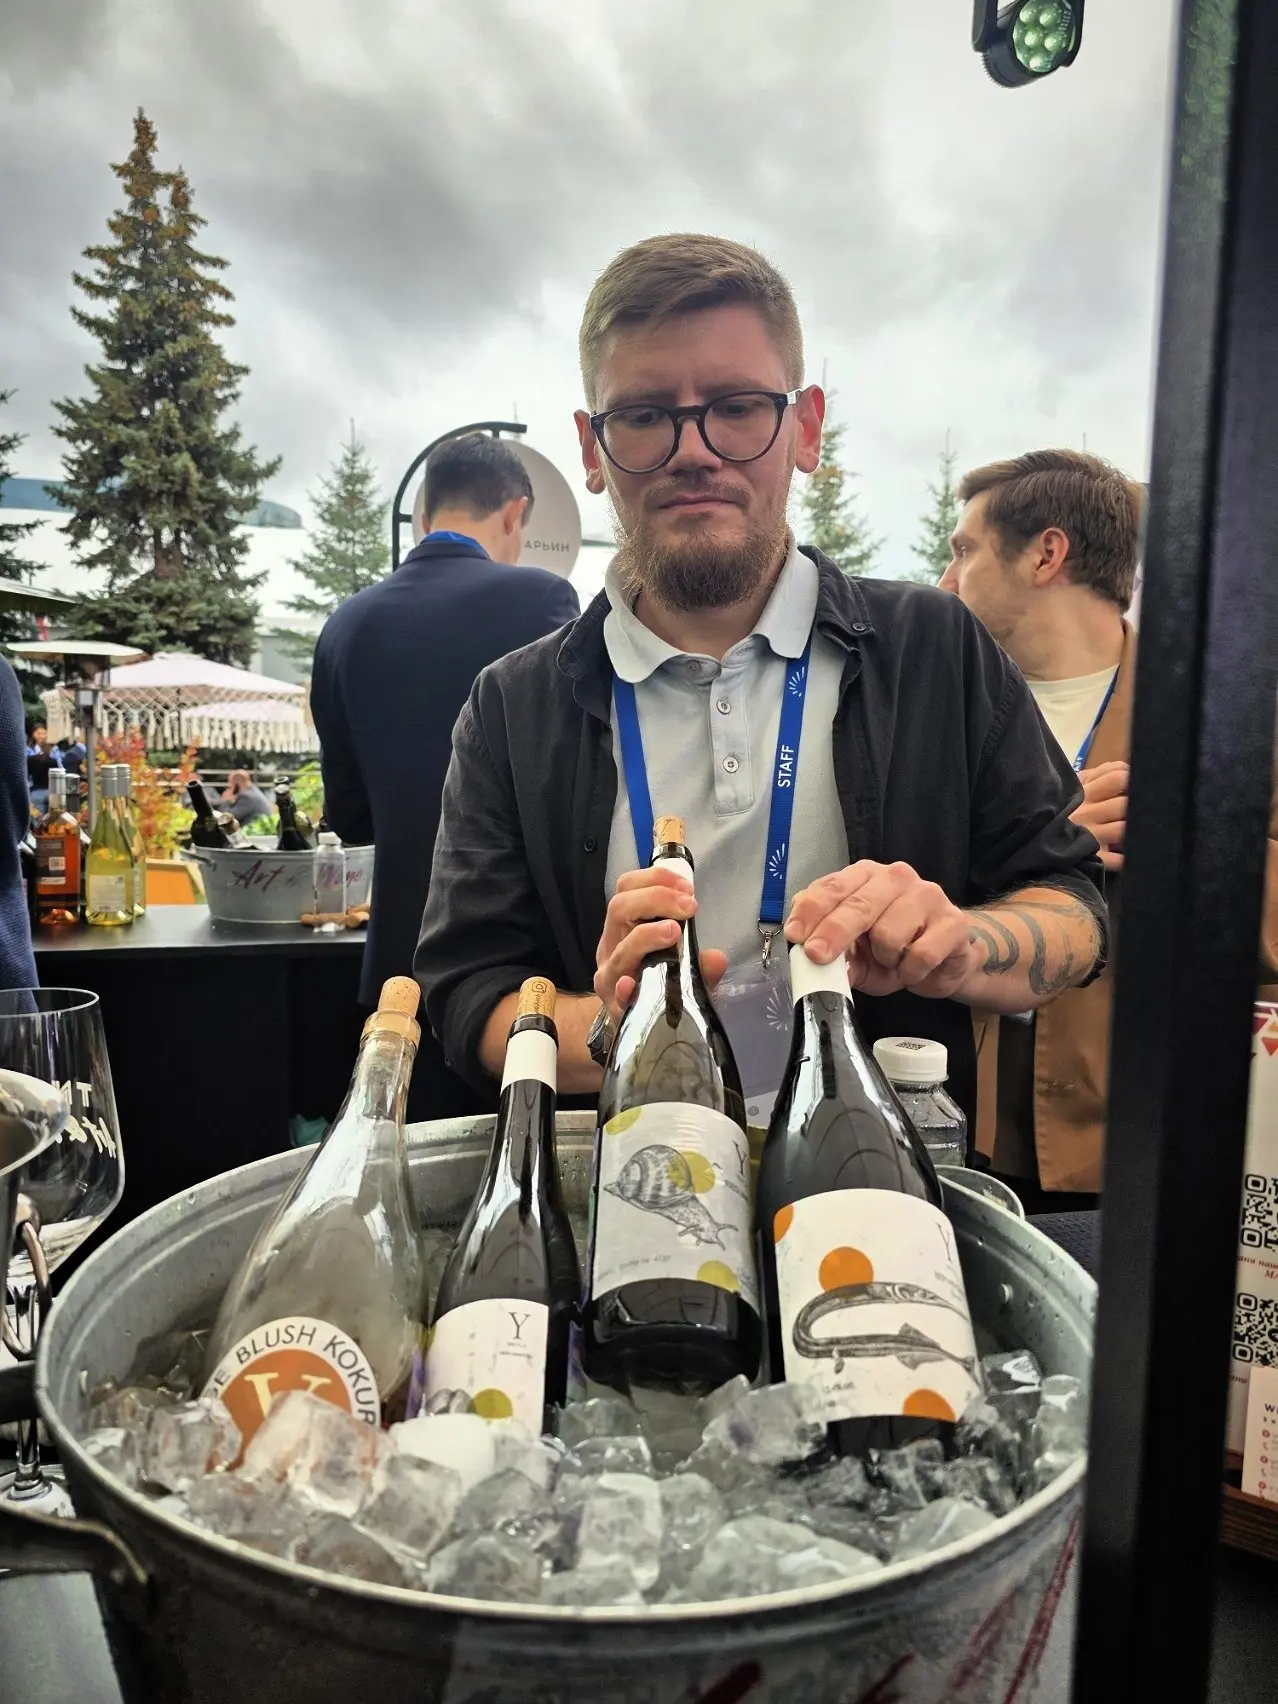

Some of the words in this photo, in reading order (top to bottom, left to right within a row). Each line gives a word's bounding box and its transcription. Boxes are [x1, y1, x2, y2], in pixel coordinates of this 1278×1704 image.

[778, 744, 795, 788] STAFF
[231, 860, 286, 893] Art
[508, 1312, 531, 1339] Y
[236, 1324, 317, 1365] BLUSH
